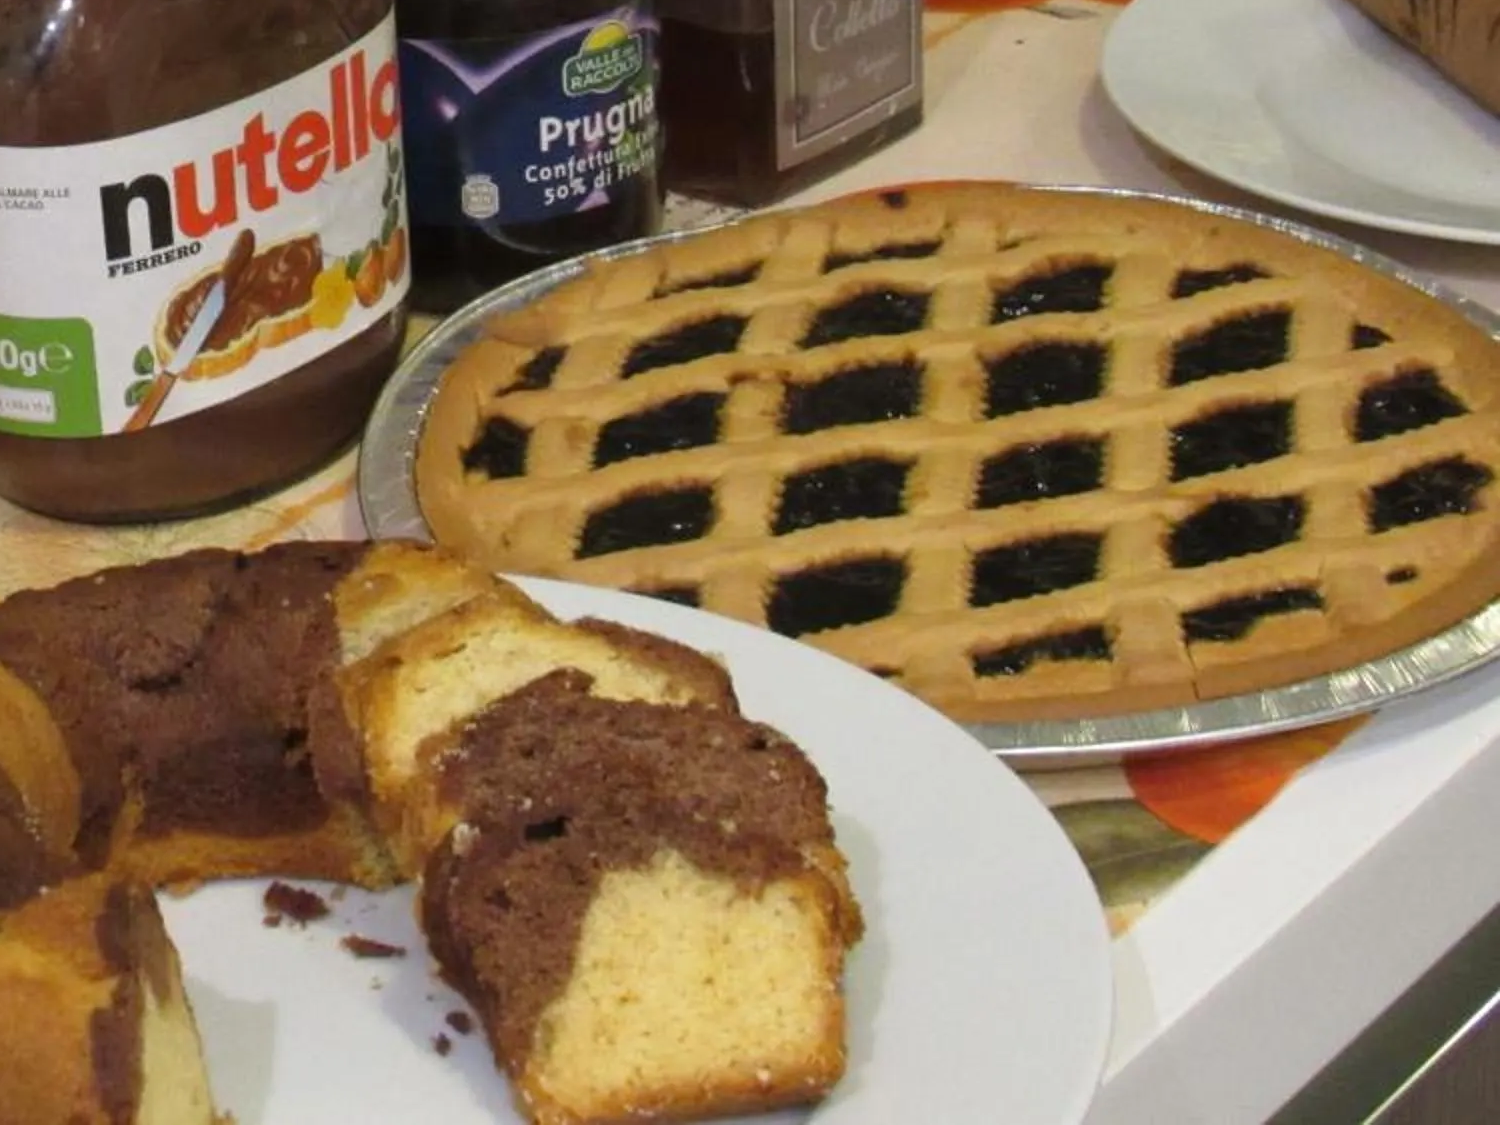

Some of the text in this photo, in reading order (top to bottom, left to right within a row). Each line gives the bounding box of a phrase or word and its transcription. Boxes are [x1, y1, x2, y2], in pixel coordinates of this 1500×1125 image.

[576, 49, 621, 74] VALLE
[543, 178, 586, 206] 50%
[594, 166, 611, 190] di
[5, 200, 44, 210] CACAO
[107, 241, 202, 278] FERRERO
